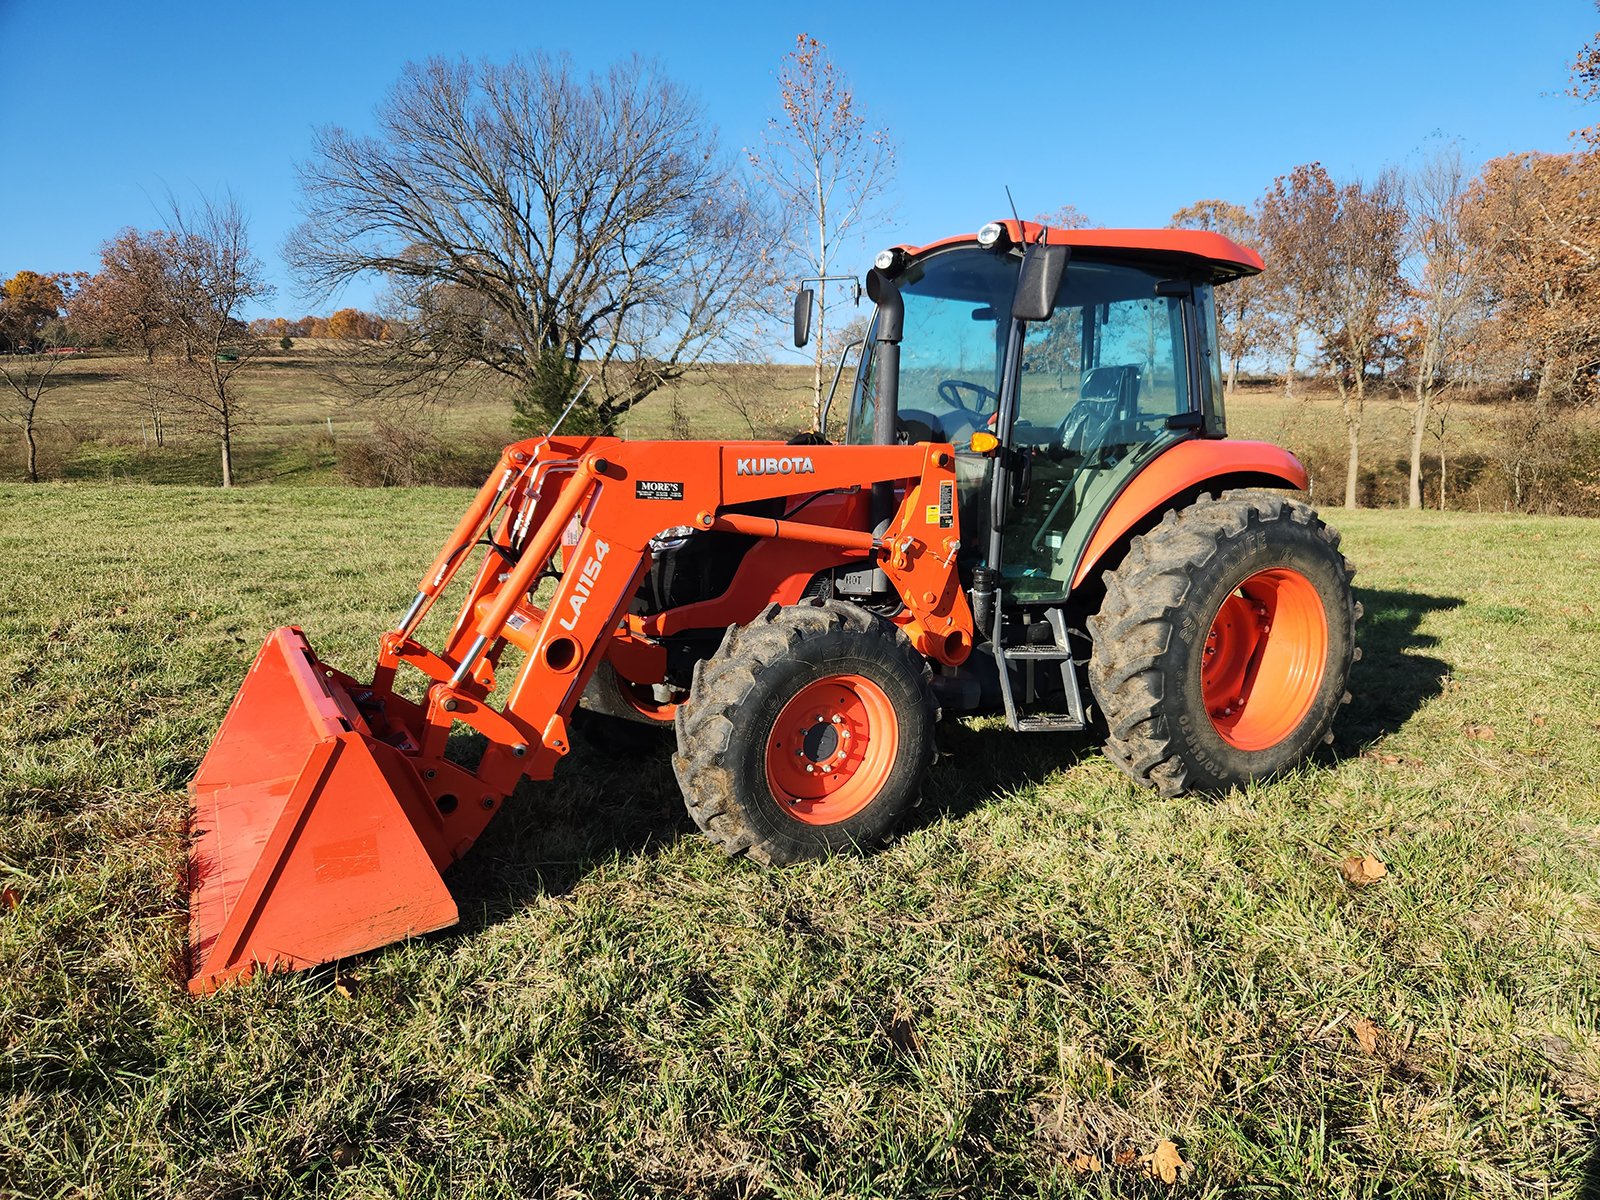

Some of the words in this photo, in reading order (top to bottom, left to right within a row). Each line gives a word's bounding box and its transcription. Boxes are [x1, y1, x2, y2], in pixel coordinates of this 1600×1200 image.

[736, 457, 815, 476] KUBOTA
[641, 482, 679, 492] MORE'S
[559, 538, 611, 631] LA1154
[845, 575, 862, 585] HOT
